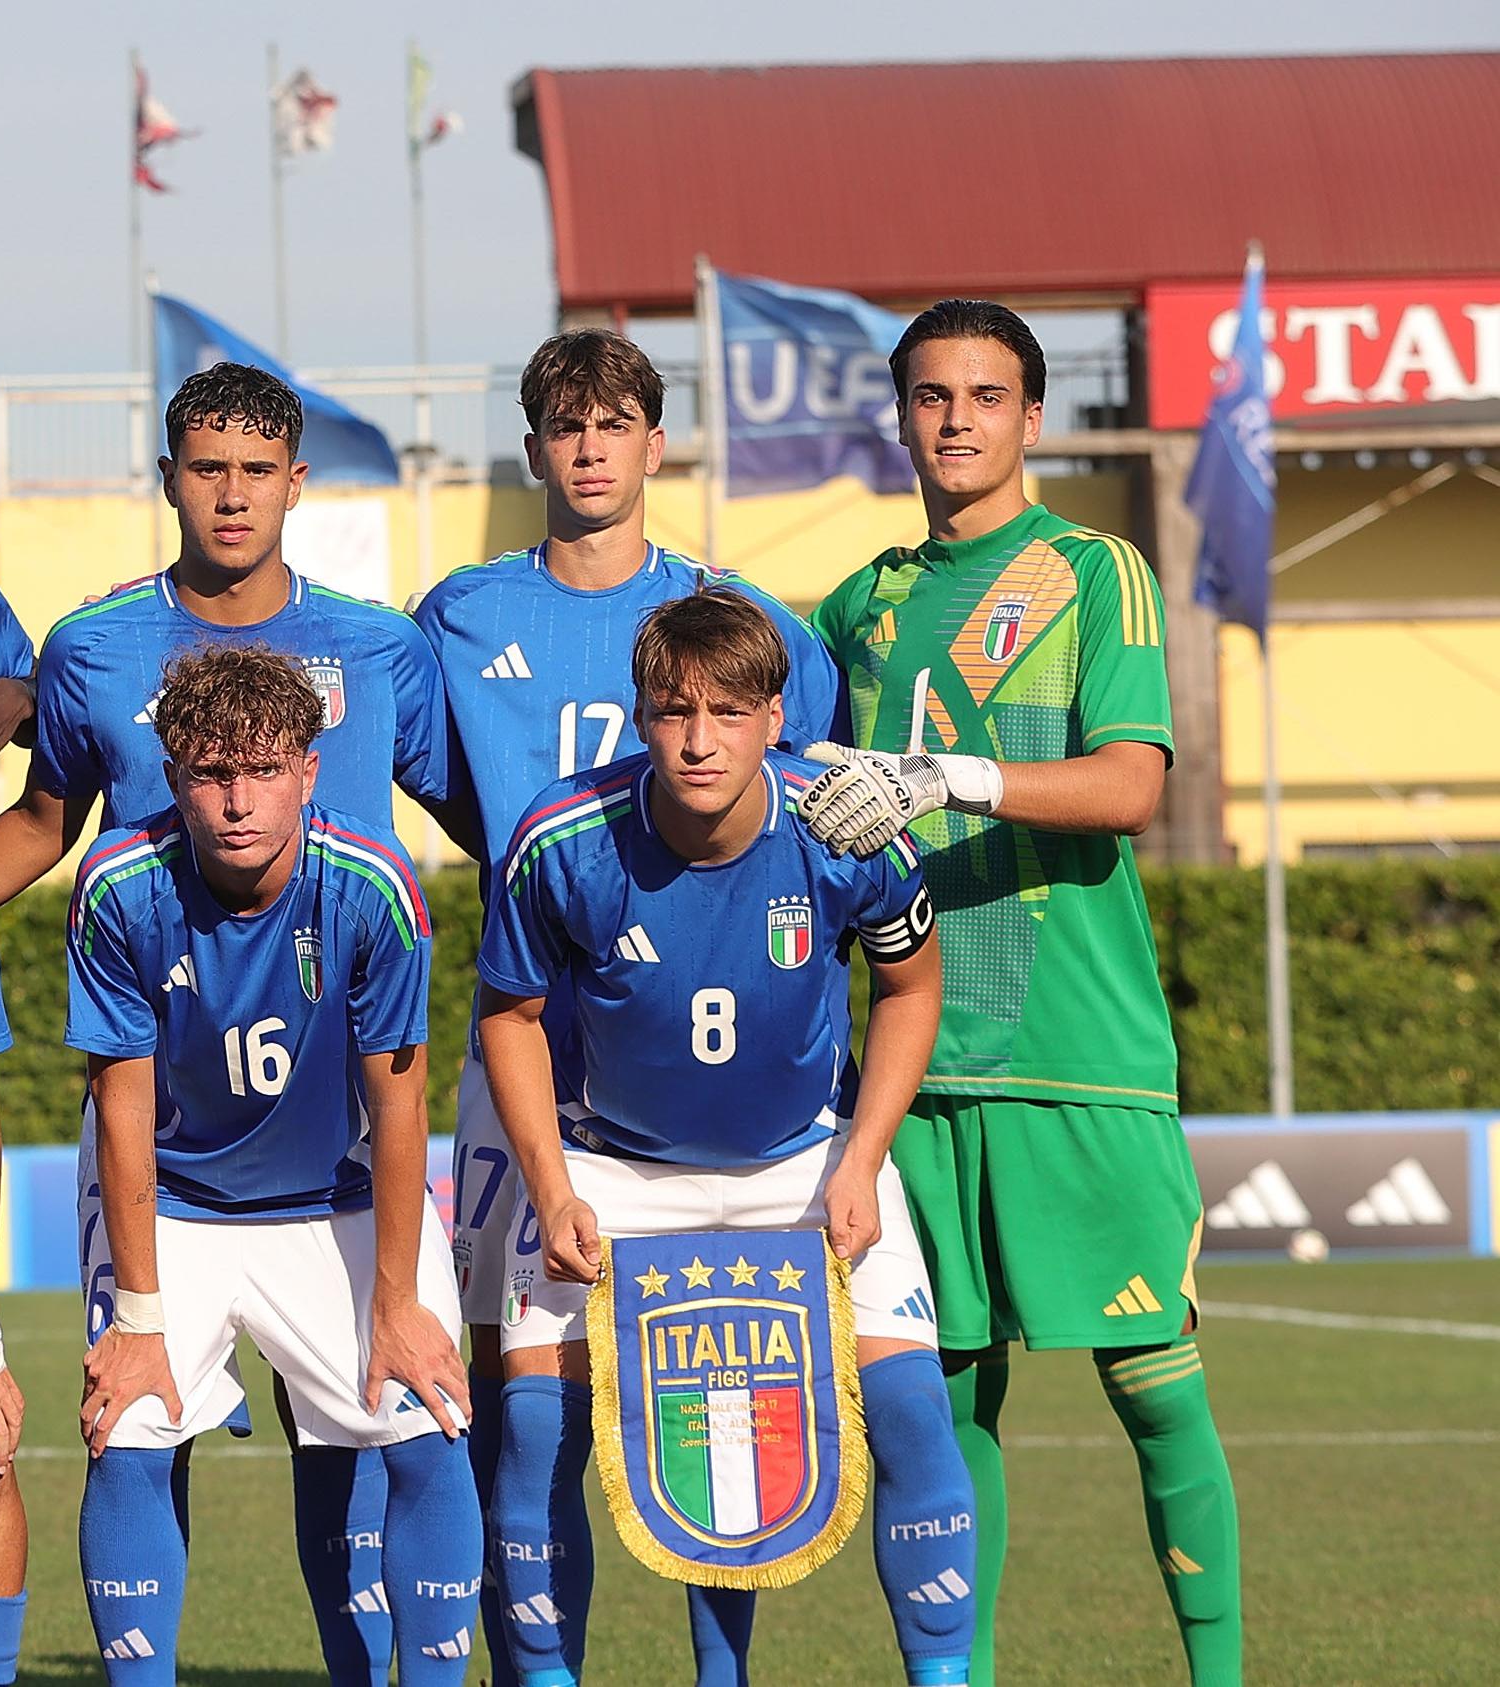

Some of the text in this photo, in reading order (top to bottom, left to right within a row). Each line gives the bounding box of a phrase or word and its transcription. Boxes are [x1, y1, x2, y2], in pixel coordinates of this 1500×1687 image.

[1208, 303, 1500, 404] STA
[728, 338, 900, 424] UEF
[994, 605, 1022, 619] ITALIA
[559, 701, 626, 780] 17
[802, 762, 851, 812] reusch
[862, 755, 911, 812] reusch
[771, 910, 808, 924] ITALIA
[691, 987, 736, 1065] 8
[224, 1017, 292, 1097] 16
[654, 1319, 797, 1371] ITALIA
[708, 1369, 748, 1389] FIGC
[890, 1513, 971, 1540] ITALIA
